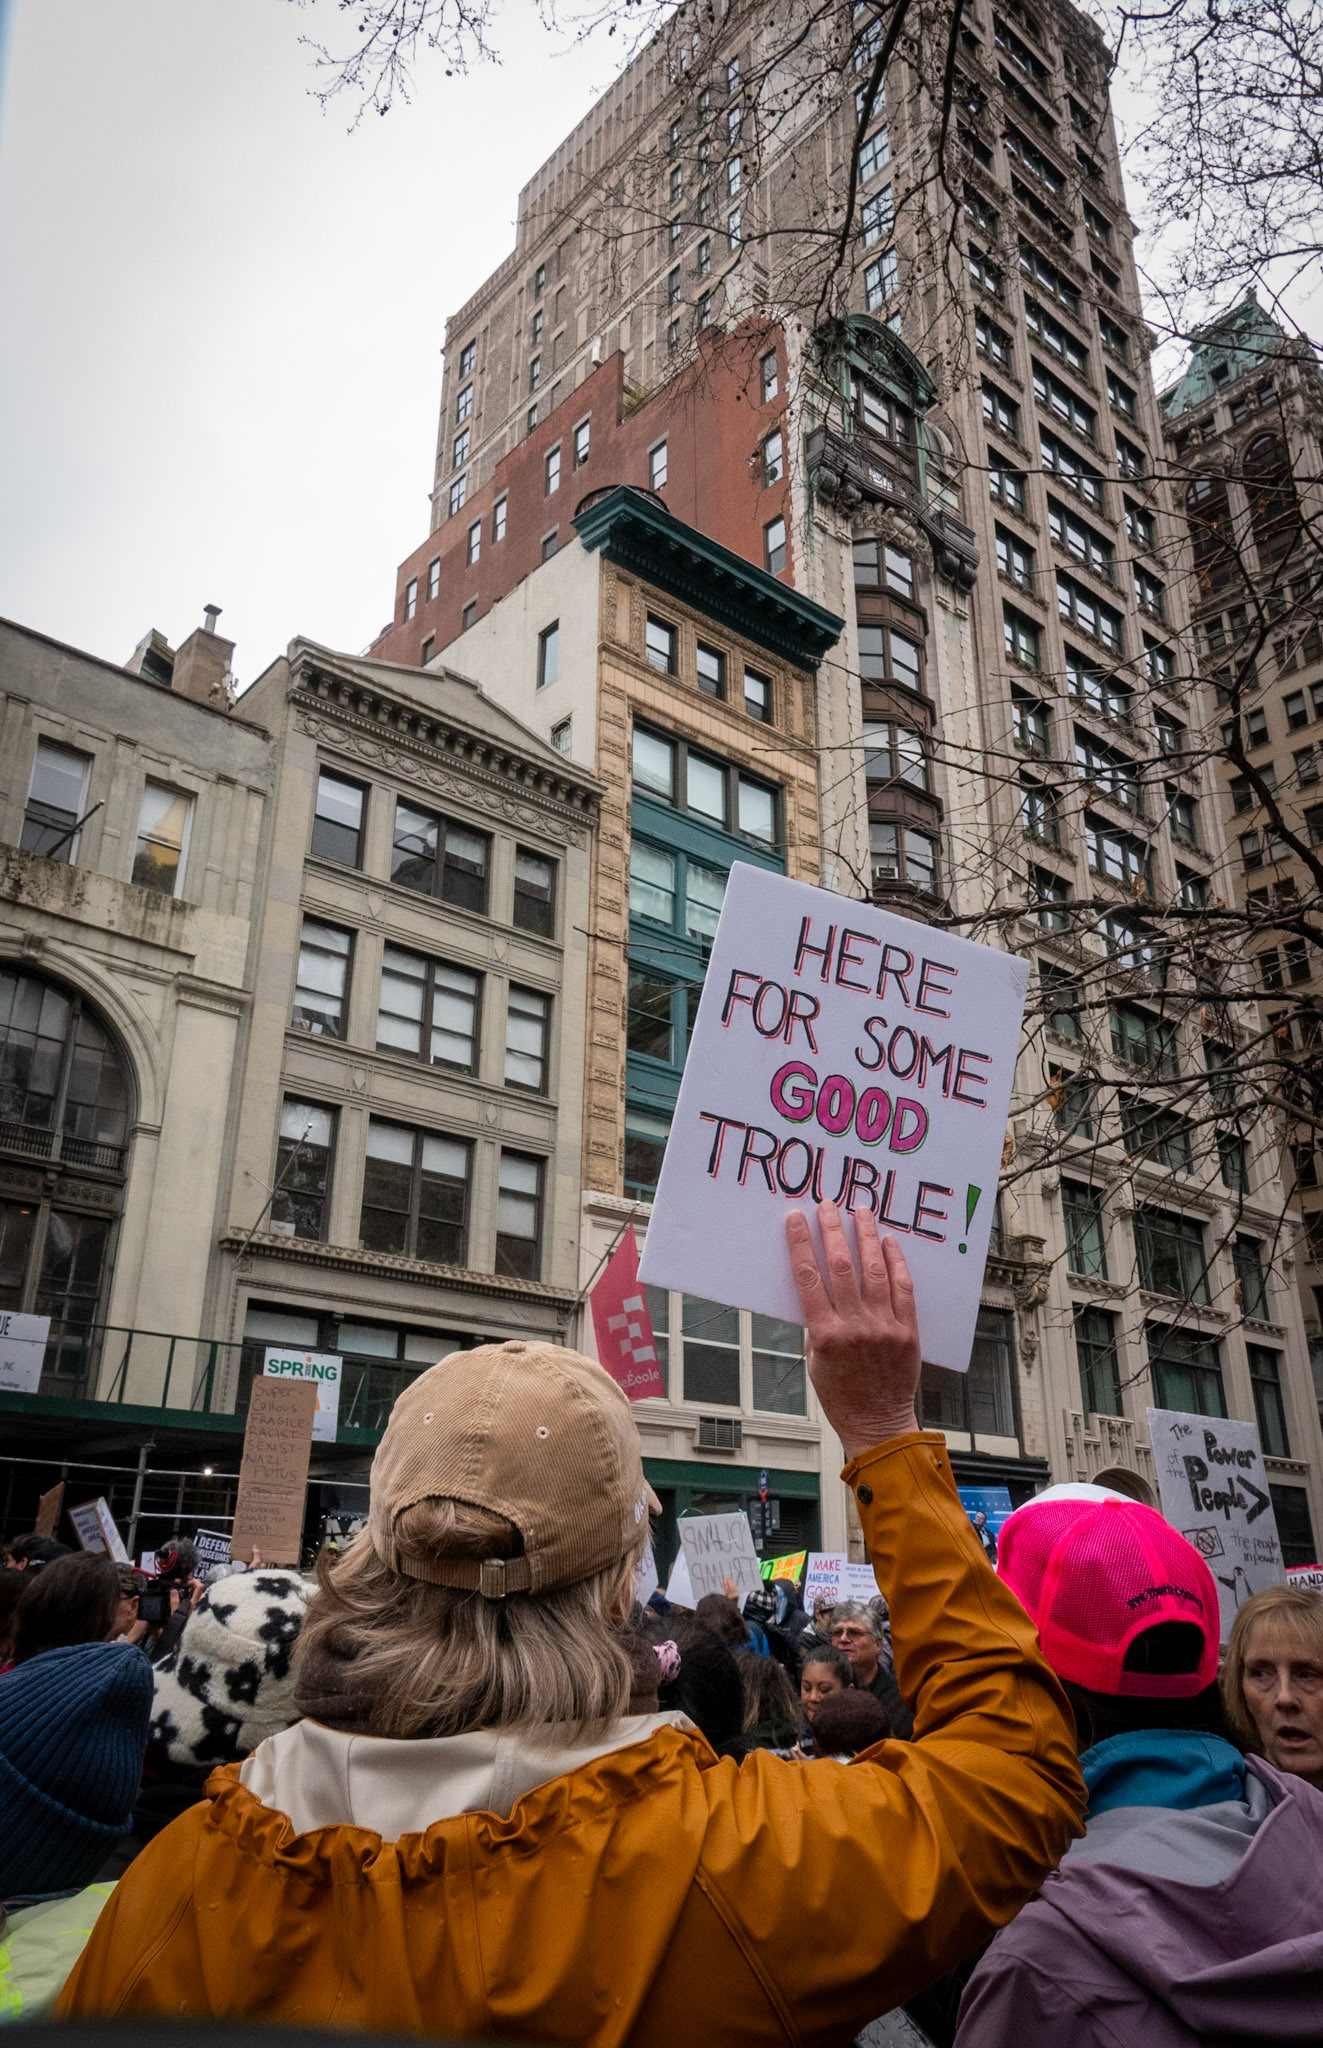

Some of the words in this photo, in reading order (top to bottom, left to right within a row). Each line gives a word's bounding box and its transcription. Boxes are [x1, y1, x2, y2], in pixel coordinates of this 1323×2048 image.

[794, 916, 958, 1018] HERE
[721, 969, 820, 1054] FOR
[854, 1016, 992, 1108] SOME
[770, 1061, 929, 1154] GOOD
[700, 1111, 982, 1254] TROUBLE!
[1168, 1449, 1179, 1465] of
[1169, 1424, 1192, 1441] The
[1203, 1429, 1256, 1469] Power
[1166, 1467, 1186, 1479] the
[1183, 1455, 1248, 1521] People
[813, 1559, 842, 1572] MAKE
[1230, 1529, 1250, 1548] the
[807, 1573, 840, 1584] AMERICA
